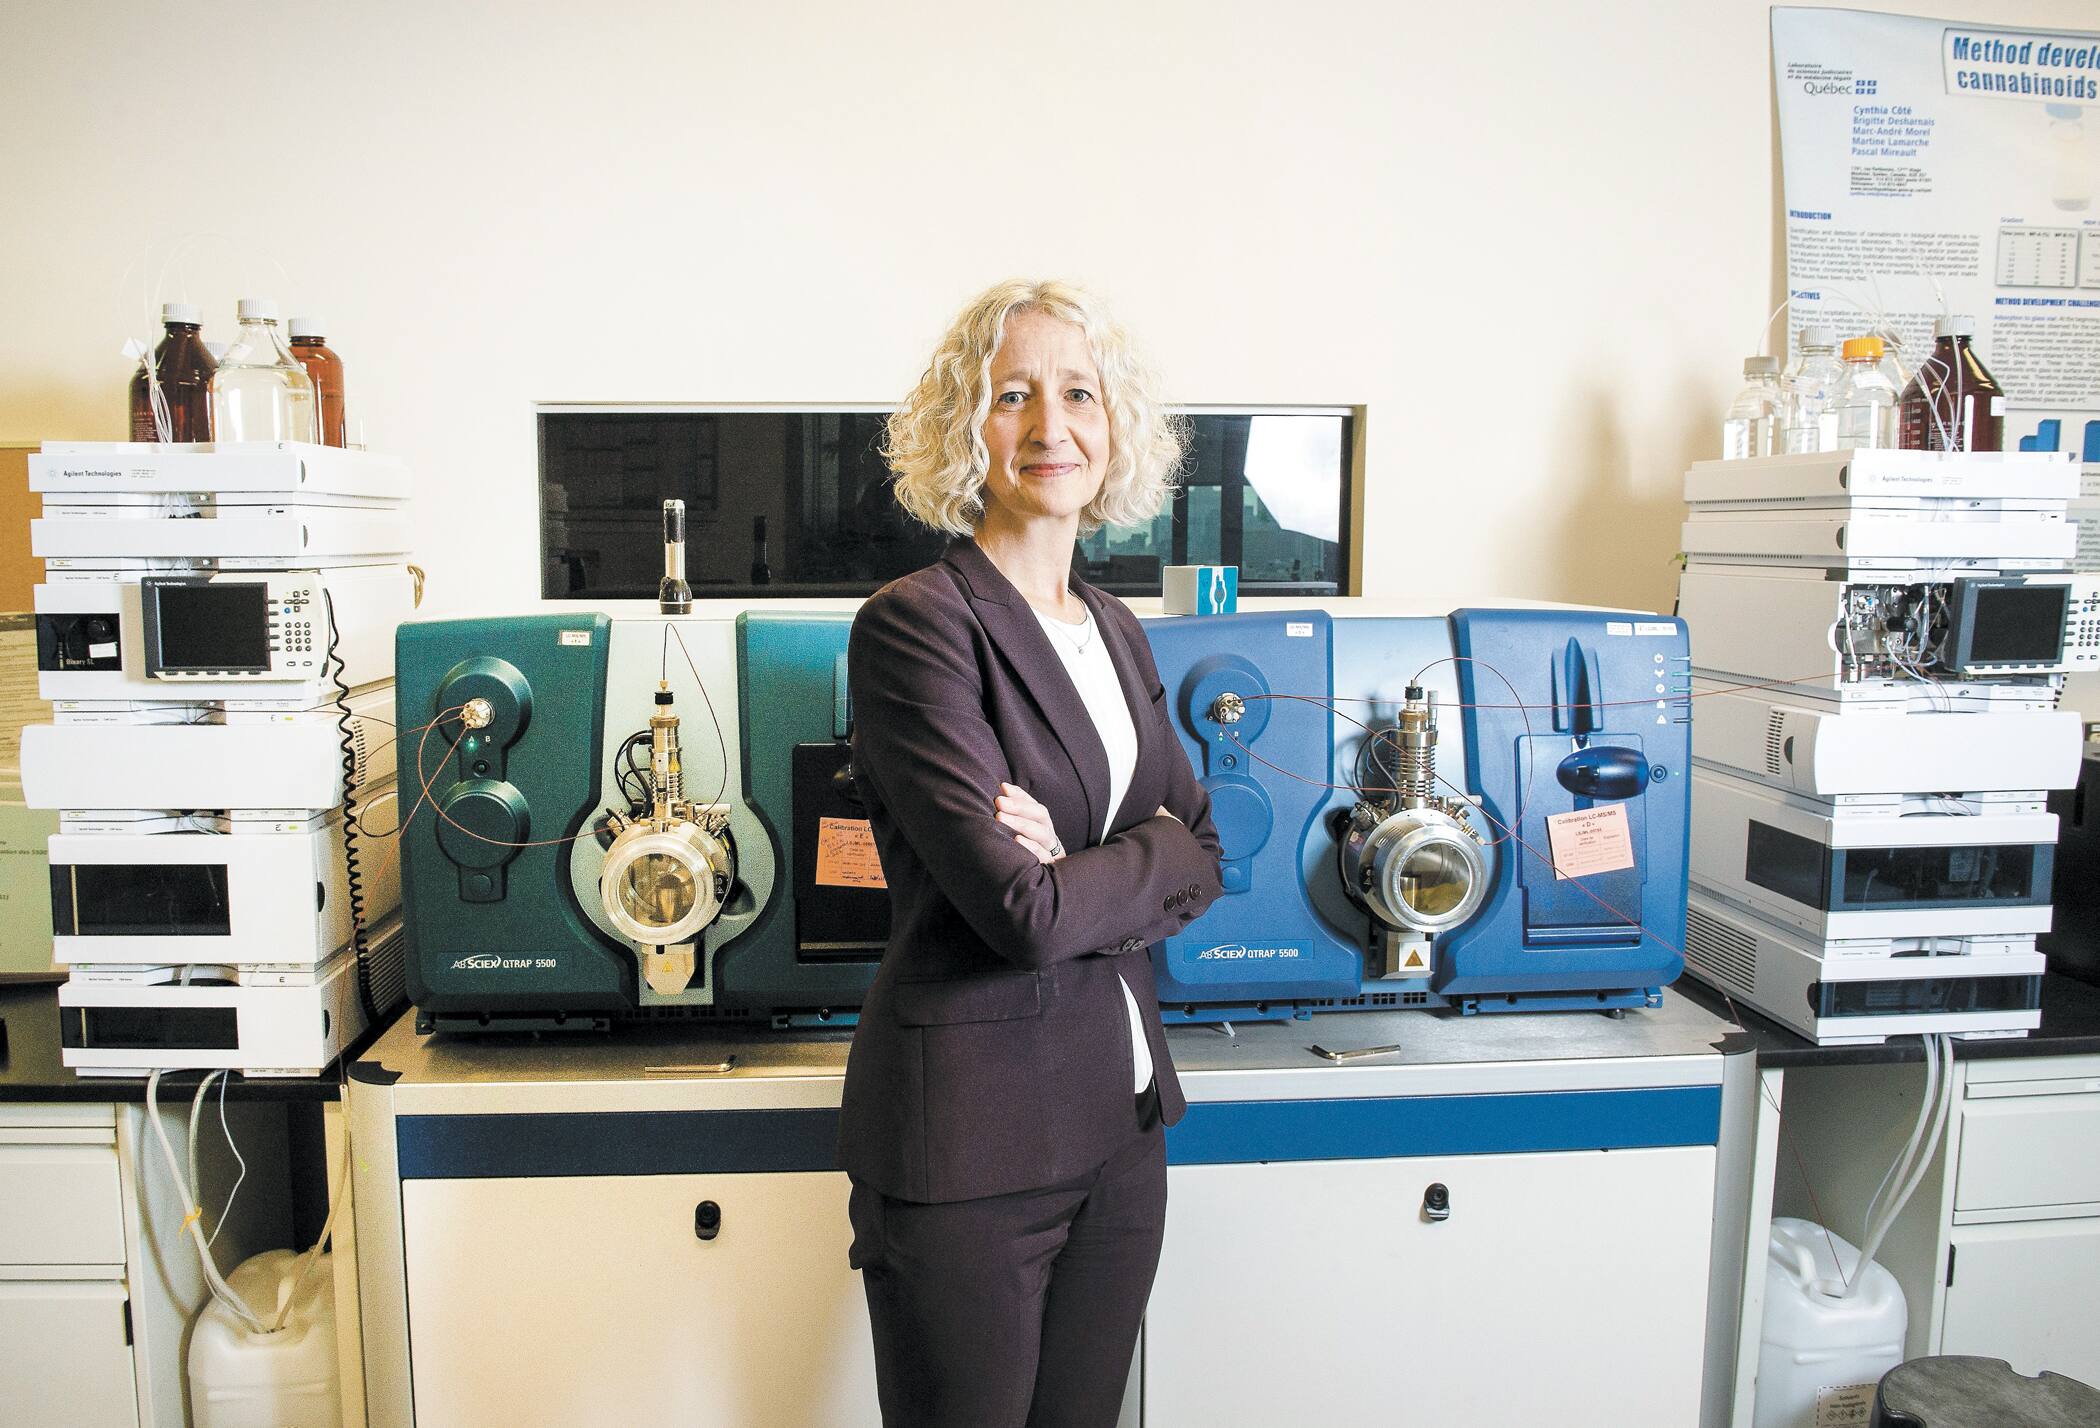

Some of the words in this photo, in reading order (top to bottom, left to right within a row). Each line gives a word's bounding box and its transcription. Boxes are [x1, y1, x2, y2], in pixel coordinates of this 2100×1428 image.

[1953, 36, 2033, 65] Method
[1803, 81, 1853, 96] Québec
[1957, 71, 2097, 99] cannabinoids
[1854, 106, 1888, 116] Cynthia
[1891, 106, 1913, 115] Côté
[1853, 116, 1885, 126] Brigitte
[1888, 117, 1935, 126] Desharnais
[1853, 127, 1903, 136] Marc-André
[1906, 128, 1931, 136] Morel
[1852, 137, 1885, 146] Martine
[1888, 138, 1930, 146] Lamarche
[1851, 147, 1878, 156] Pascal
[1881, 148, 1917, 157] Mireault
[63, 470, 84, 478] Agilent
[85, 470, 122, 478] Technologies
[468, 735, 475, 743] A
[485, 735, 491, 743] B
[829, 823, 862, 832] Calibration
[1213, 949, 1243, 959] SCIEX
[1247, 949, 1276, 959] QTRAP
[1279, 948, 1299, 958] 5500
[467, 959, 498, 969] SCIEX
[502, 959, 533, 969] QTRAP
[535, 958, 557, 968] 5500
